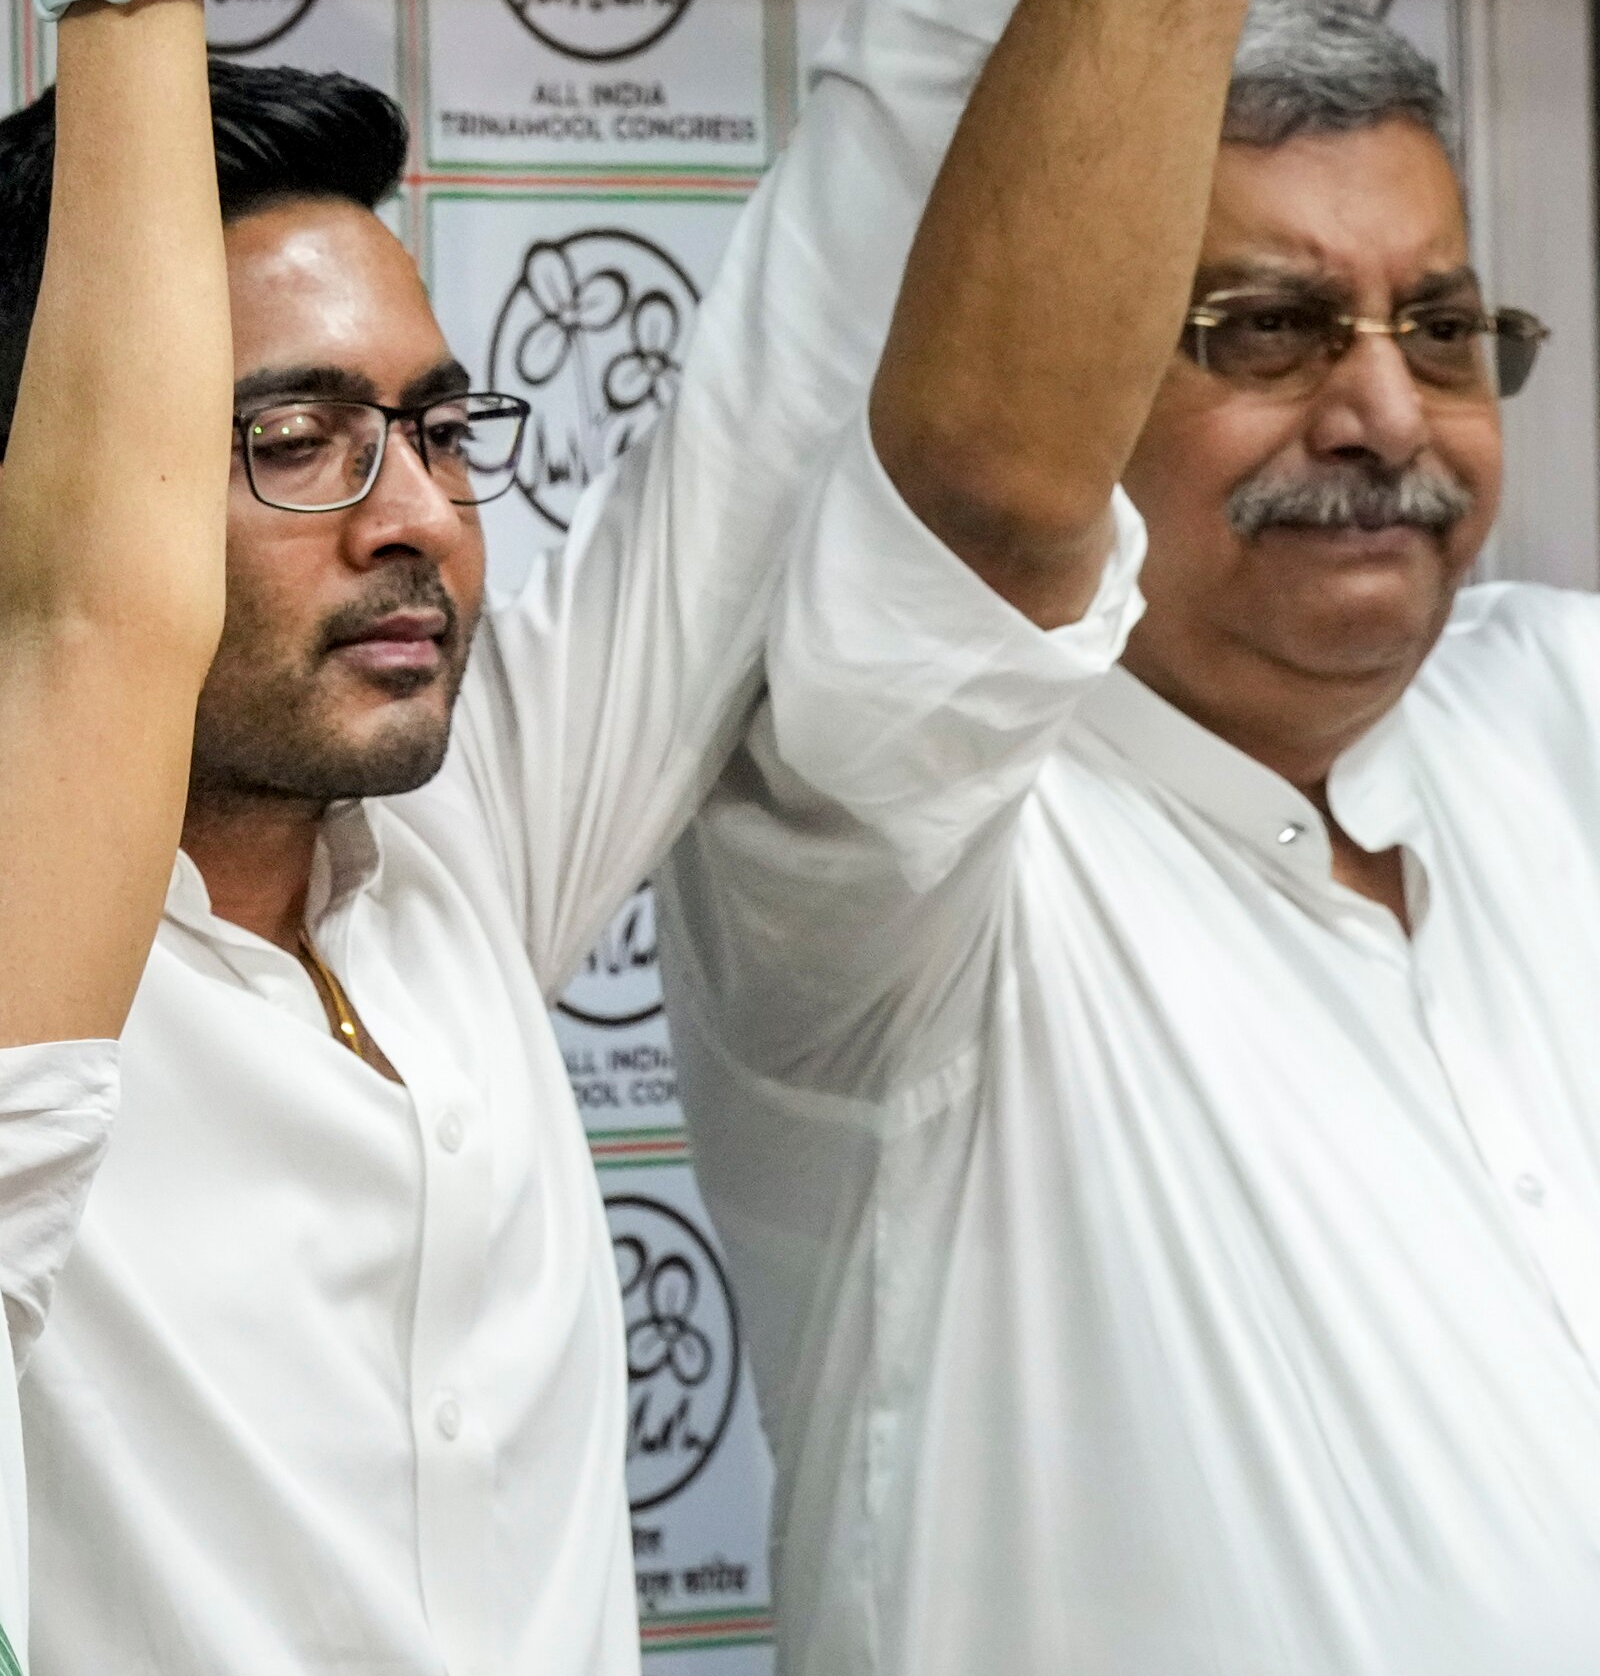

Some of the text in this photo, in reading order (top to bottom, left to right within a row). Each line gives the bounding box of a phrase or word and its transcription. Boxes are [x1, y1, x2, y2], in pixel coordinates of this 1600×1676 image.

[531, 81, 667, 108] ALL INDIA
[440, 110, 756, 145] TRINAMOOL CONGRESS
